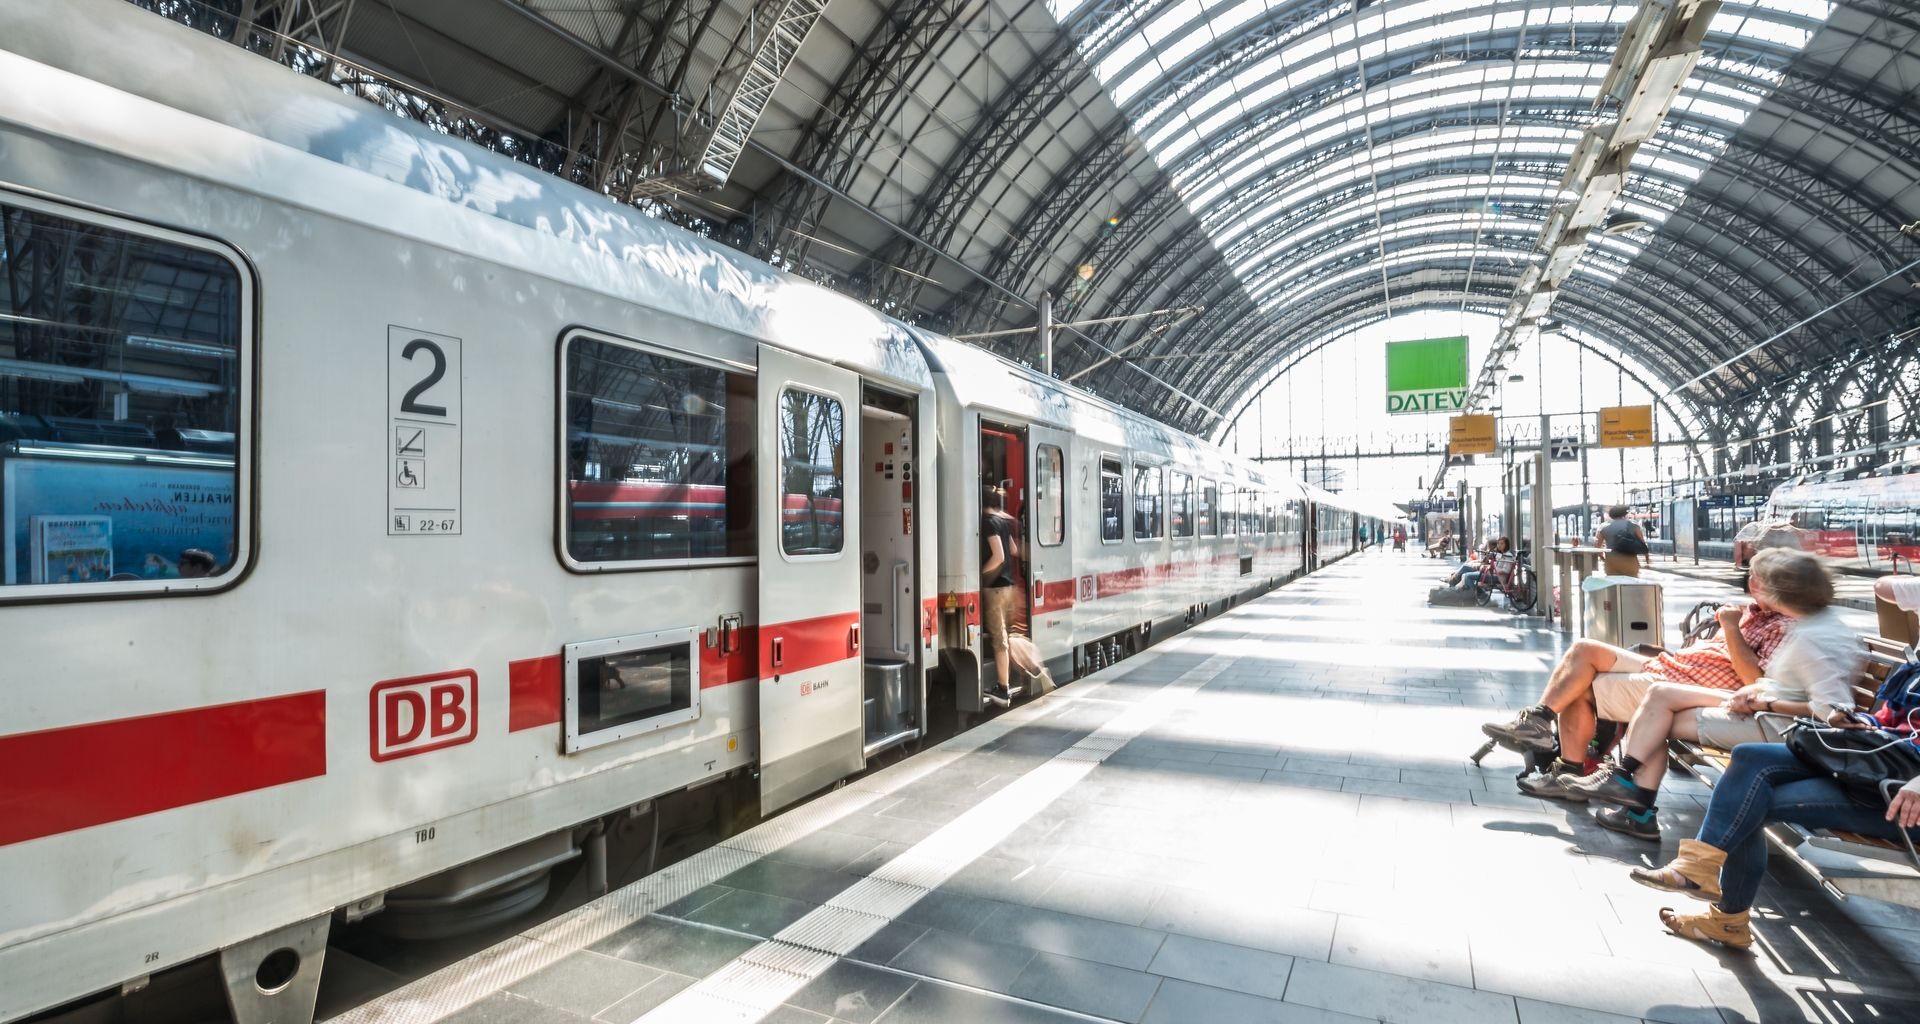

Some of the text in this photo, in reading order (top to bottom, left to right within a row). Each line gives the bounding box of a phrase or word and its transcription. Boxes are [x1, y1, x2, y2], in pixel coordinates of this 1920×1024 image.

[400, 338, 447, 416] 2
[1387, 390, 1467, 412] DATEV
[1556, 438, 1576, 459] A
[420, 519, 455, 531] 22-67
[813, 680, 829, 691] BAHN
[383, 682, 468, 749] DB
